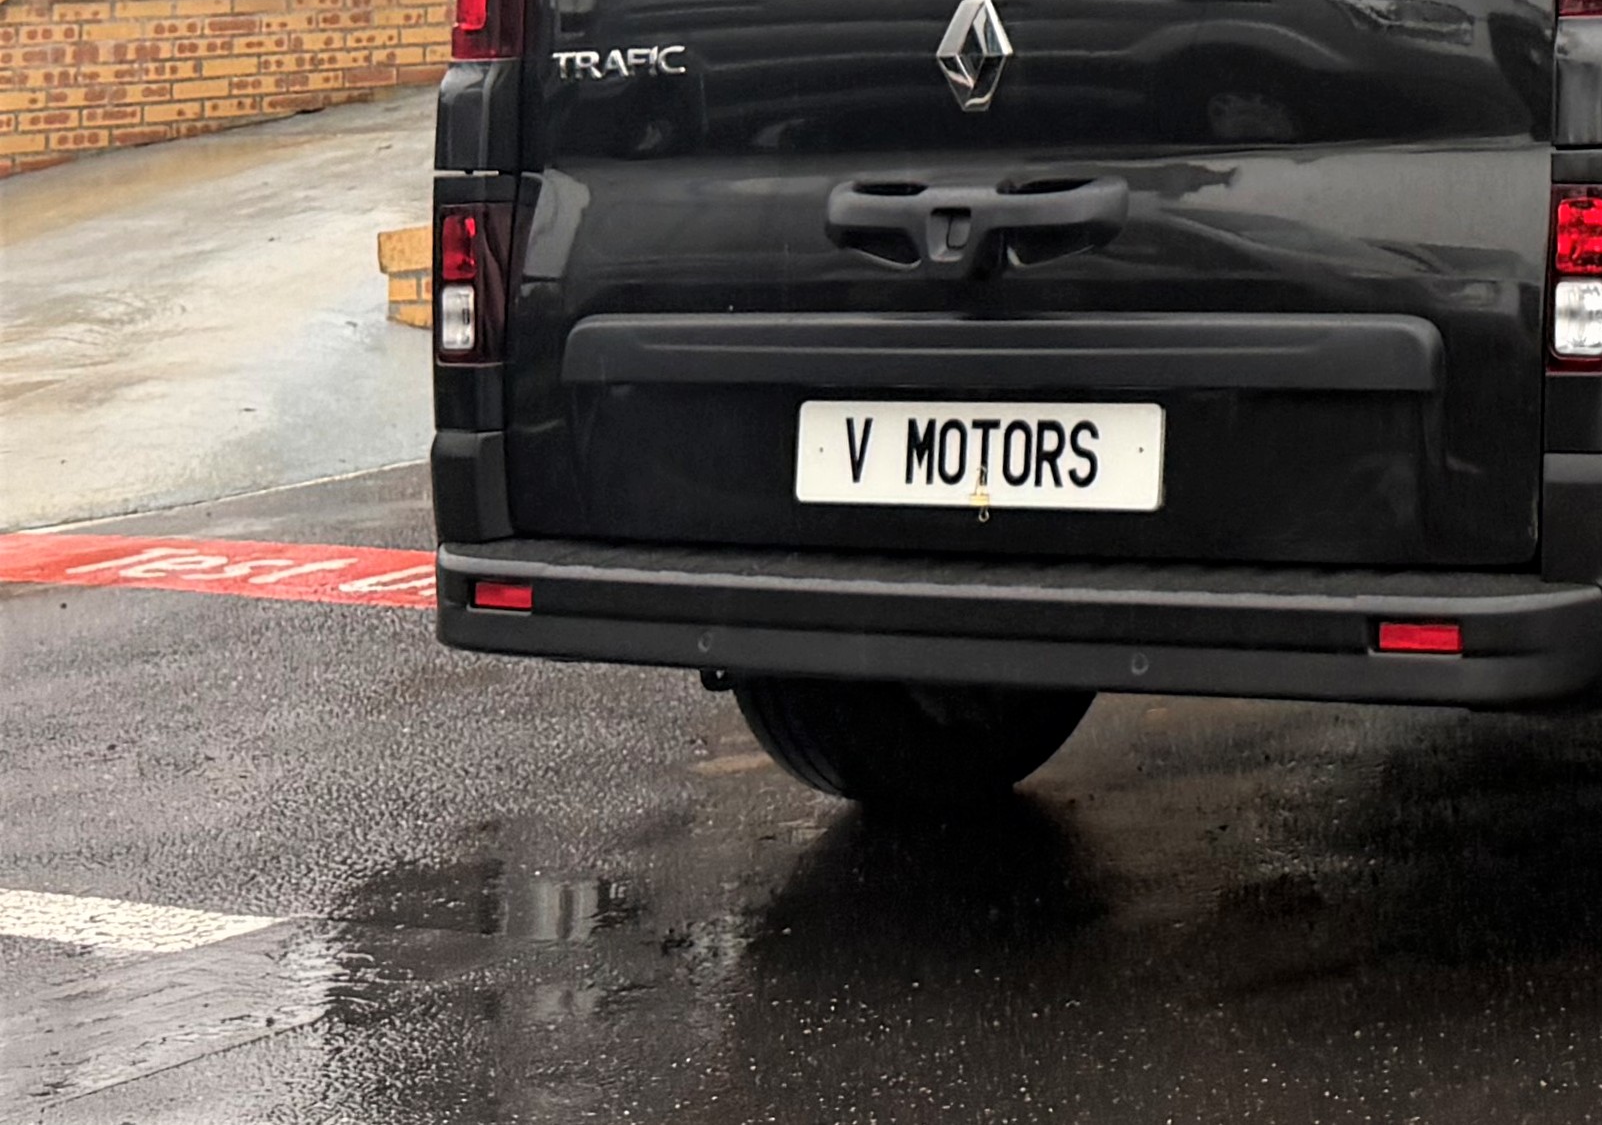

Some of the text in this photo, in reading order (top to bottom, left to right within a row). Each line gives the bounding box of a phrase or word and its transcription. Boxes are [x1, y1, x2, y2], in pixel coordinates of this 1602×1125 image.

[552, 45, 686, 79] TRAFIC
[845, 417, 1100, 488] V MOTORS
[66, 546, 358, 585] Test
